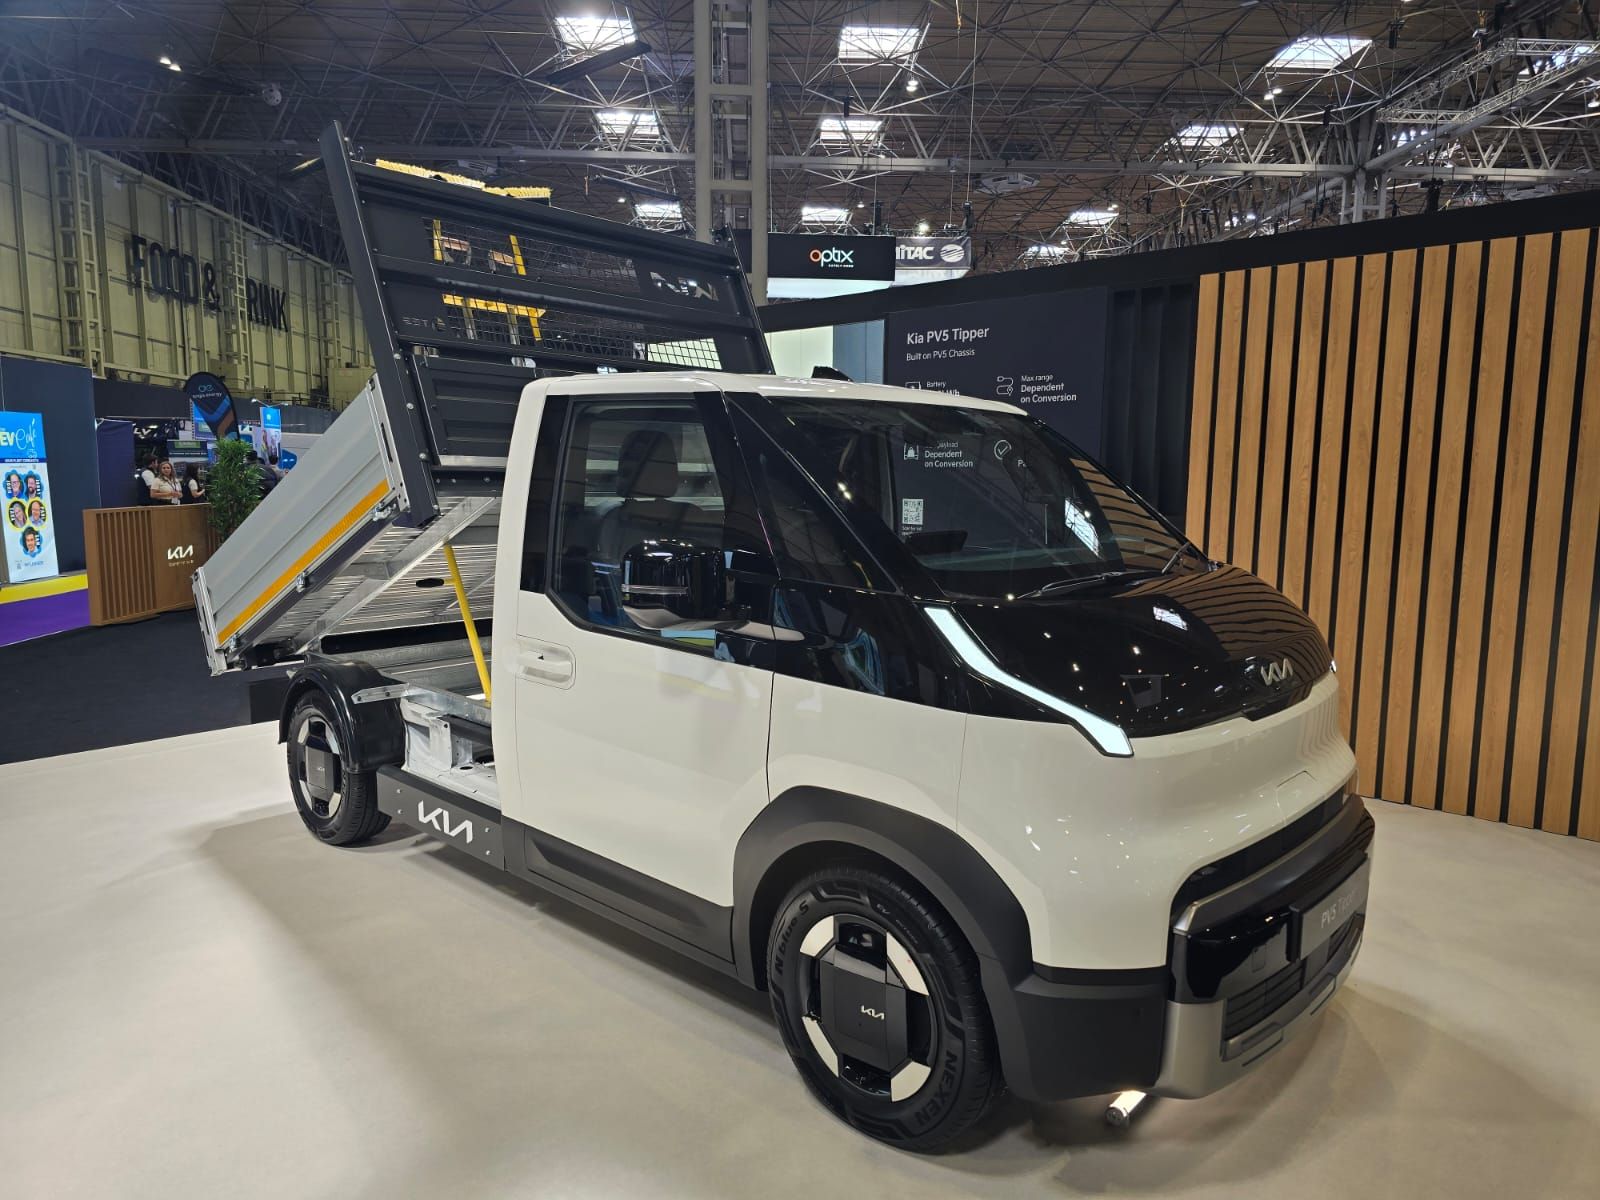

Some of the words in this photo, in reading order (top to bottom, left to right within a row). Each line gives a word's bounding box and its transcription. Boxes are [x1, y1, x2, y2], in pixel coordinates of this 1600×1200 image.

[809, 247, 854, 268] optix
[132, 234, 199, 305] FOOD
[204, 262, 222, 313] &
[239, 277, 289, 333] RINK
[907, 332, 924, 345] Kia
[926, 328, 949, 343] PV5
[952, 327, 990, 343] Tipper
[906, 352, 921, 361] Built
[933, 349, 947, 359] PV5
[948, 347, 976, 358] Chassis
[1020, 382, 1065, 394] Dependent
[1020, 396, 1031, 404] on
[1031, 393, 1077, 403] Conversion
[924, 450, 962, 459] Dependent
[934, 459, 974, 468] Conversion
[167, 544, 194, 560] KIA
[1260, 658, 1294, 686] KIA
[417, 799, 473, 844] KIA
[860, 1004, 885, 1020] KIA
[914, 1049, 958, 1126] NEXEN
